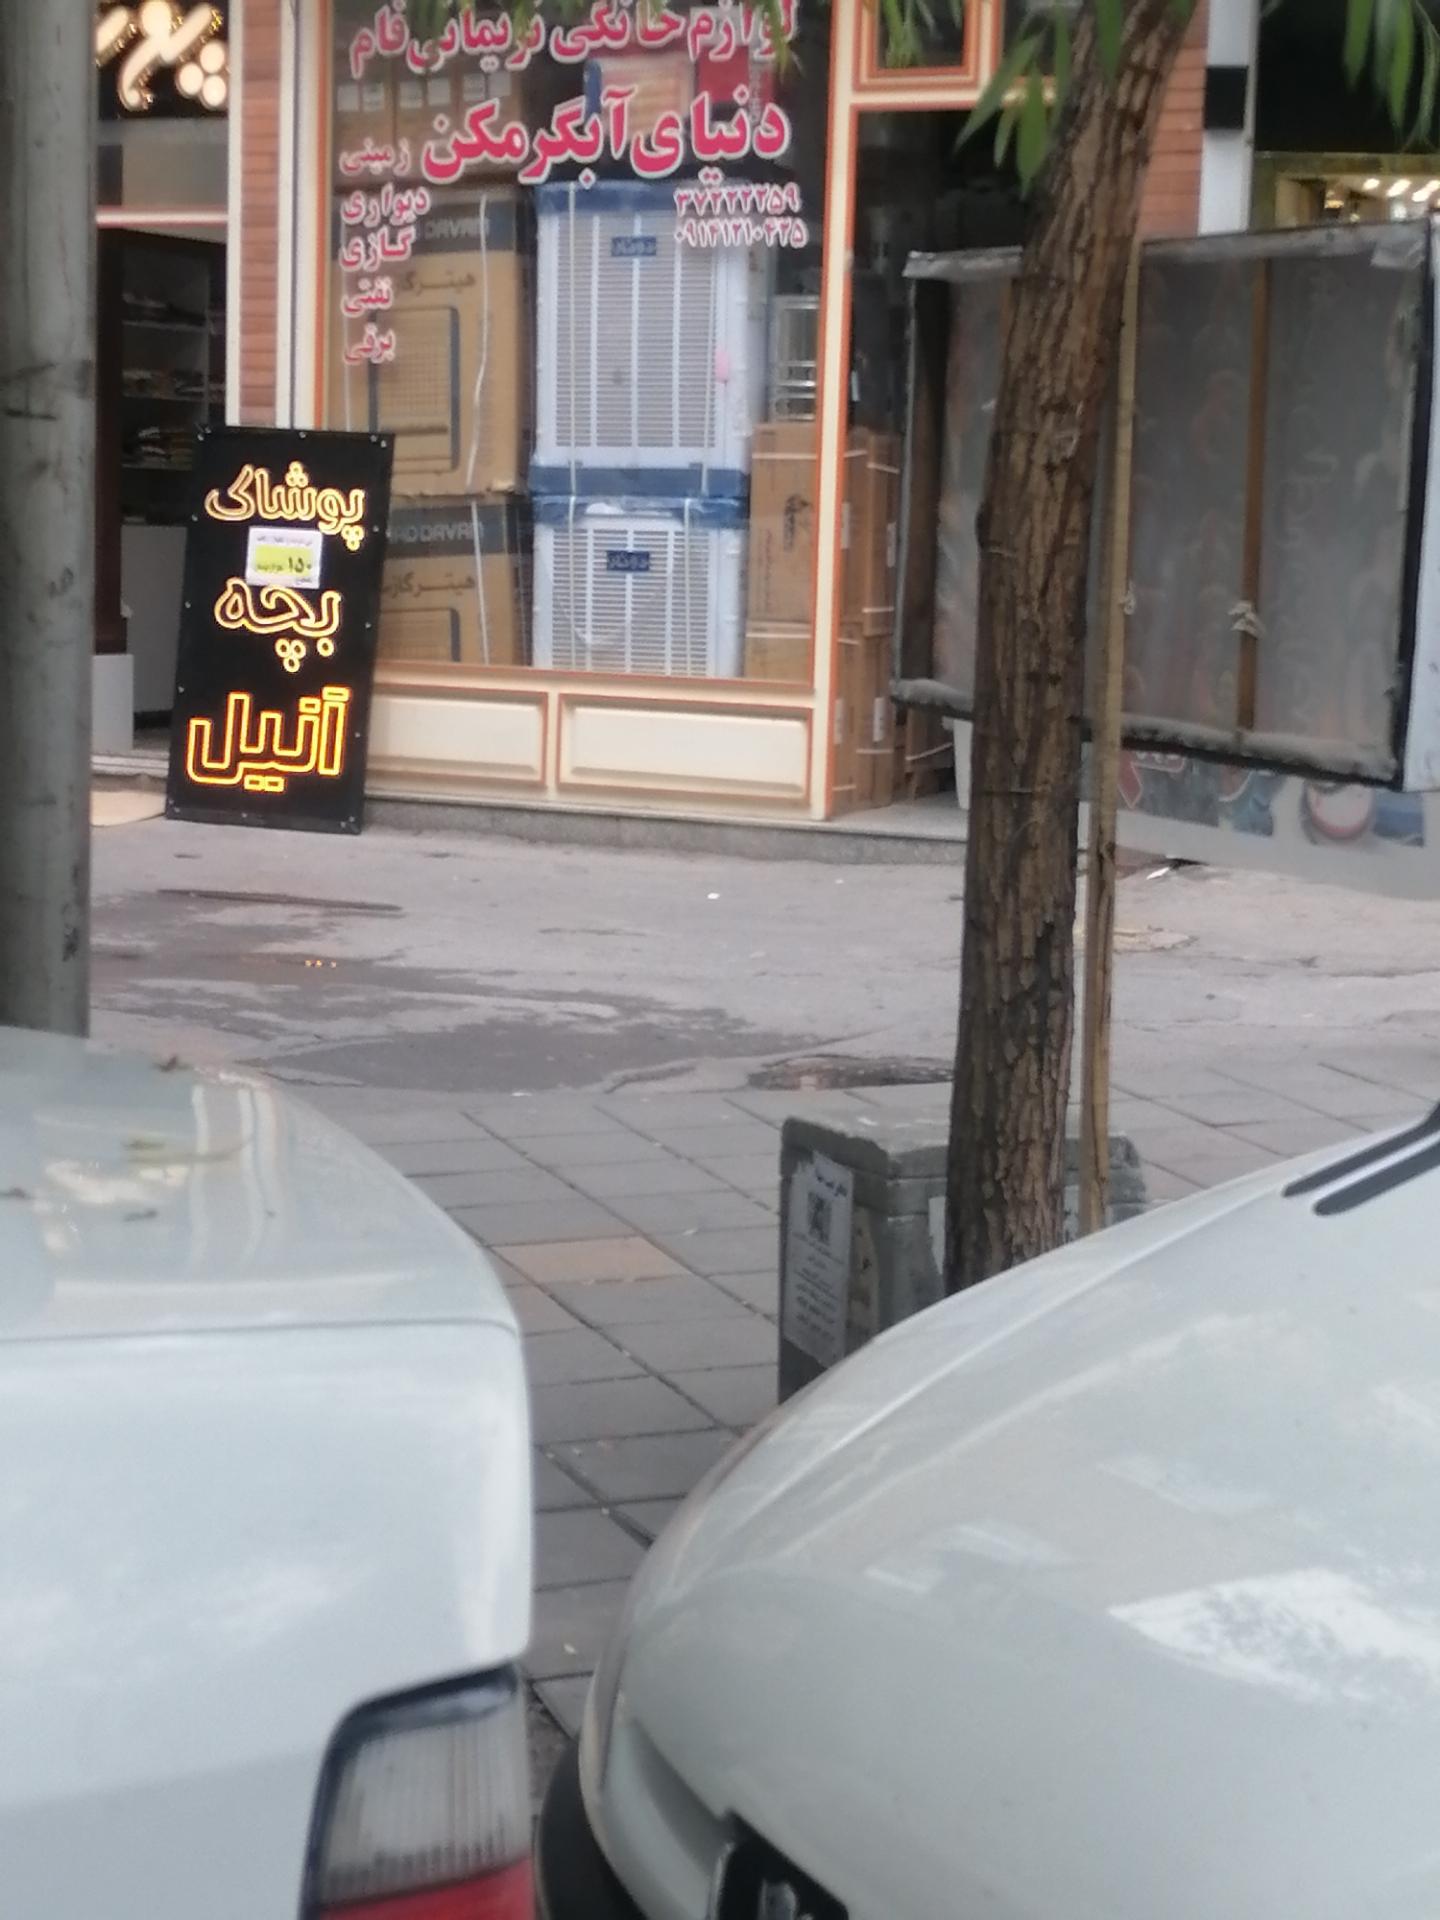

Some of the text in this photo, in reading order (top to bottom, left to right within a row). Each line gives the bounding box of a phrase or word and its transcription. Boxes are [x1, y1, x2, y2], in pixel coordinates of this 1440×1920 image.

[550, 0, 687, 64] خانگی
[687, 0, 798, 61] لوازم
[631, 85, 791, 184] دنیای
[341, 182, 431, 228] دیواری
[204, 461, 366, 551] پوشاک
[214, 577, 342, 673] بچه
[187, 686, 352, 792] آنیل
